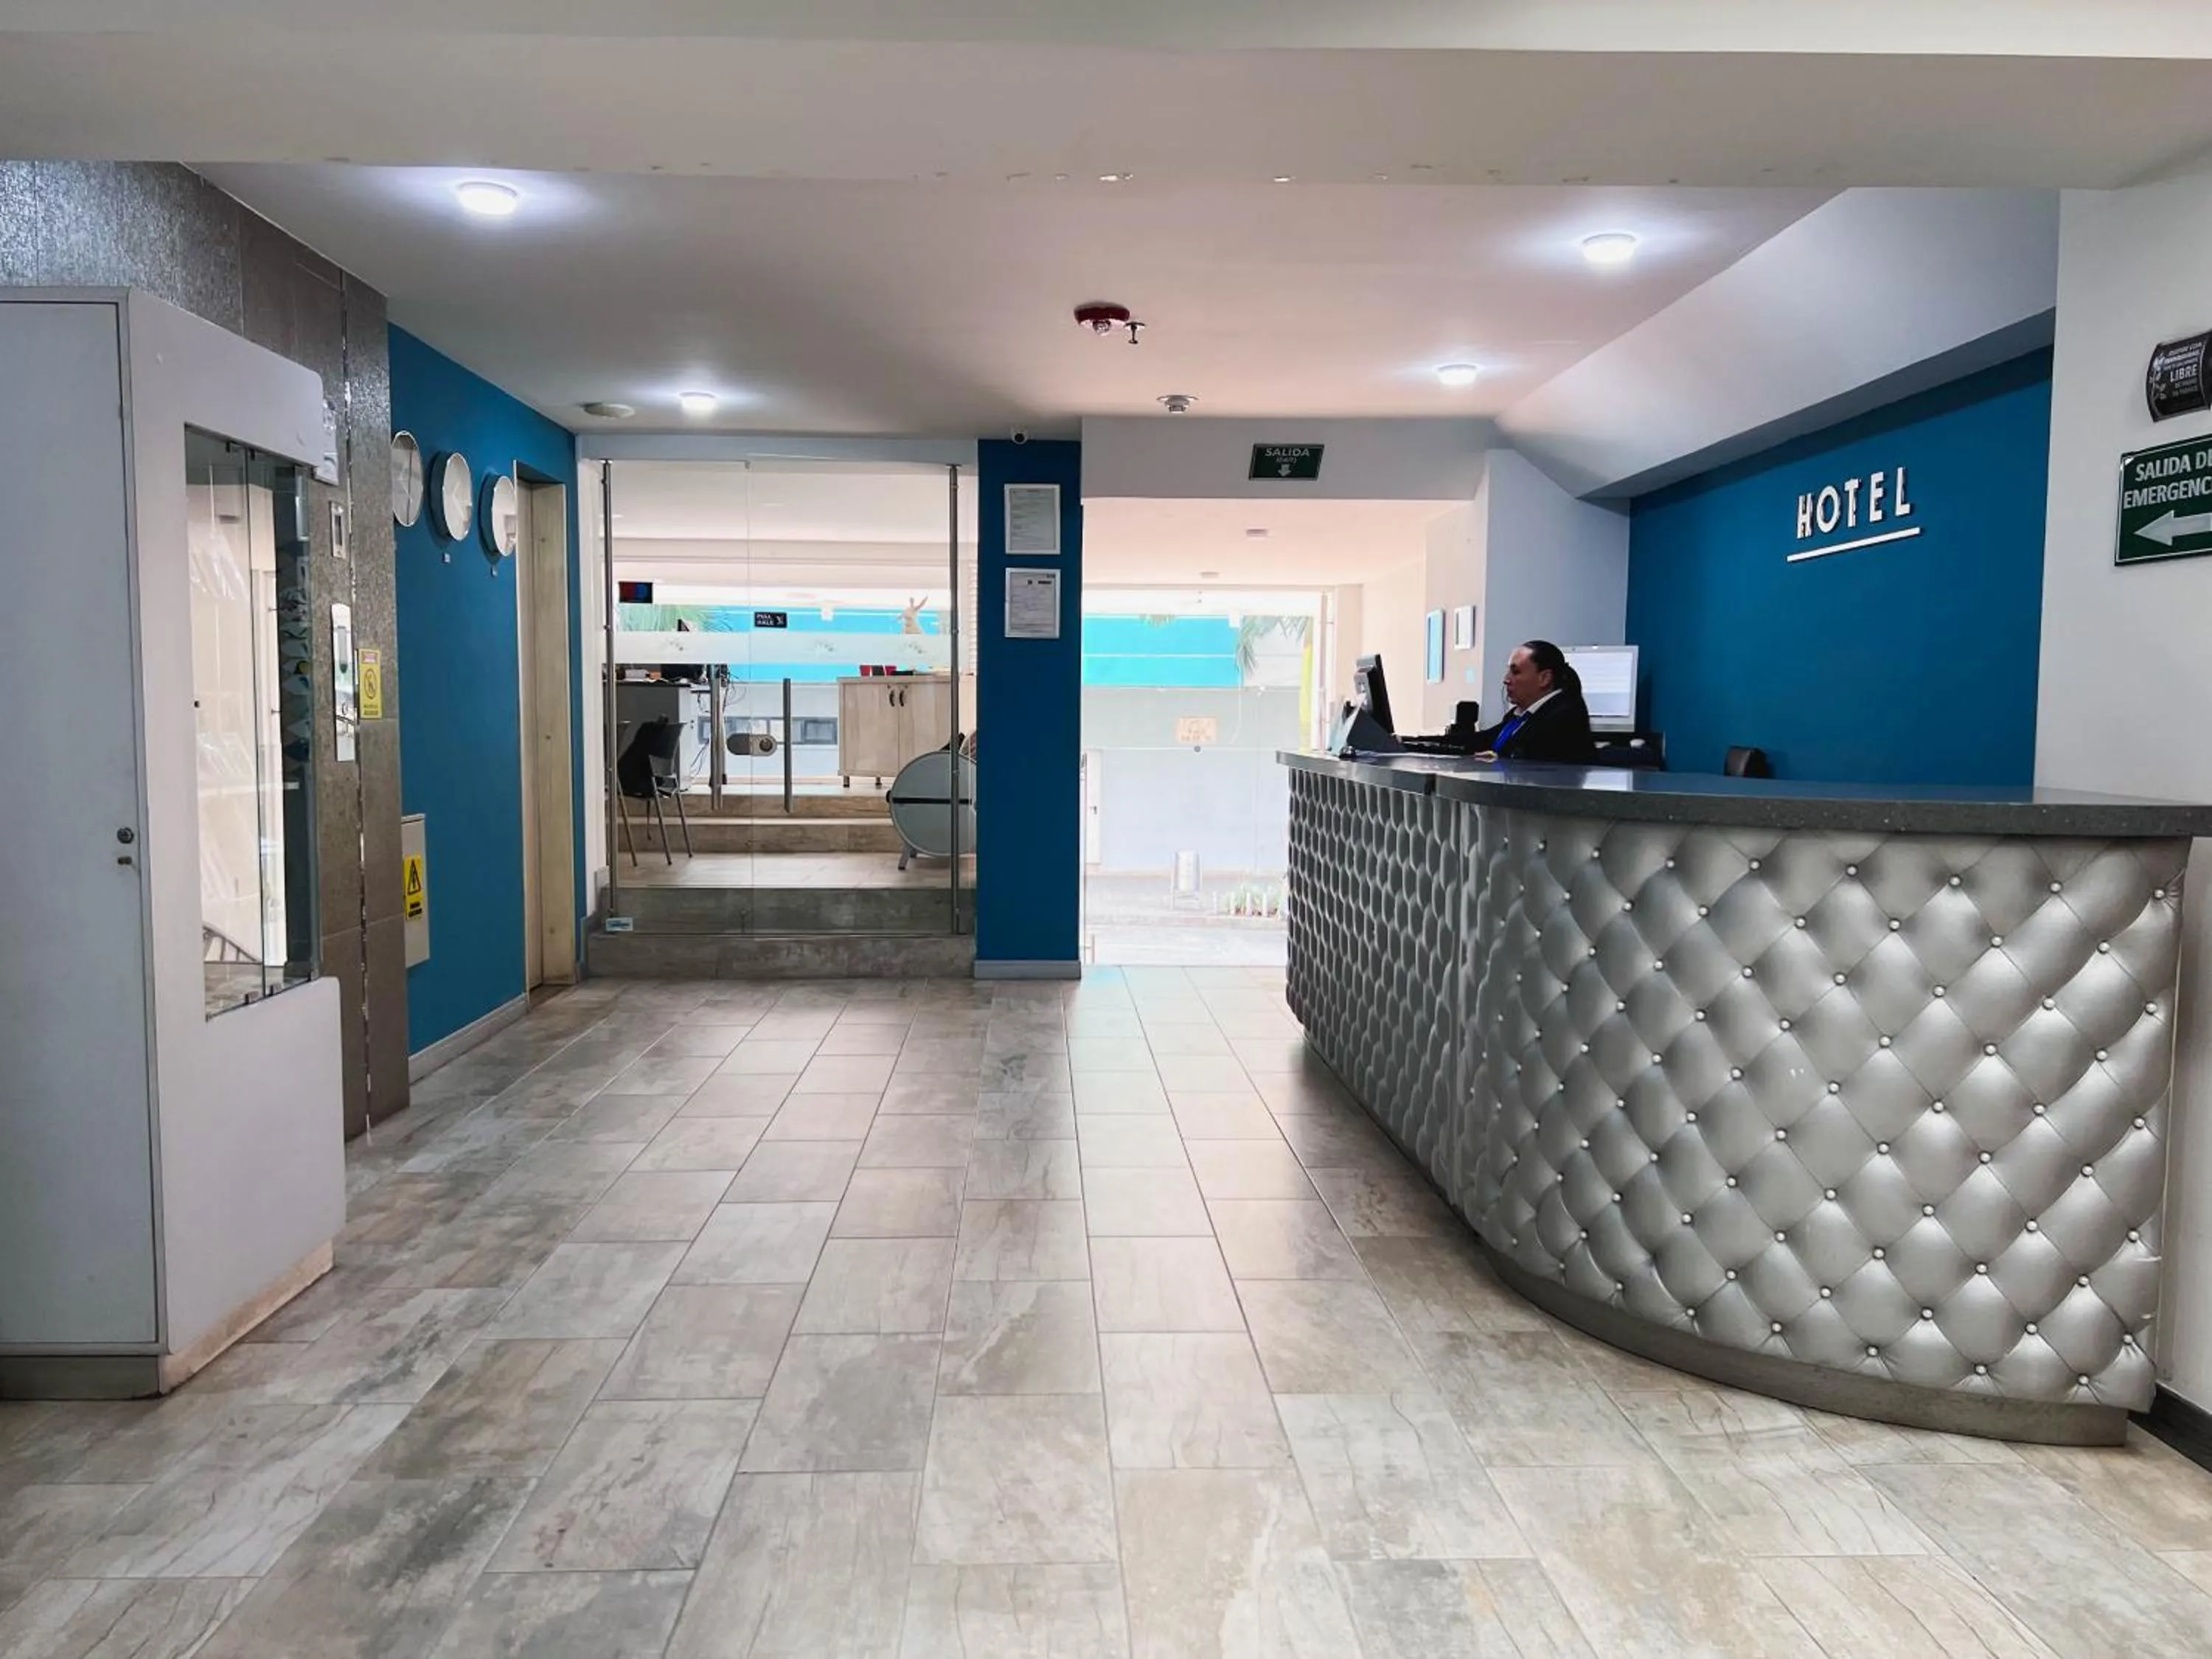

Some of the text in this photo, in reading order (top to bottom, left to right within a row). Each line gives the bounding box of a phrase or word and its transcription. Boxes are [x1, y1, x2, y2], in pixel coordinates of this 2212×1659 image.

[2170, 364, 2198, 383] LIBRE
[1265, 448, 1310, 456] SALIDA
[2135, 454, 2191, 481] SALIDA
[1797, 466, 1911, 539] HOTEL
